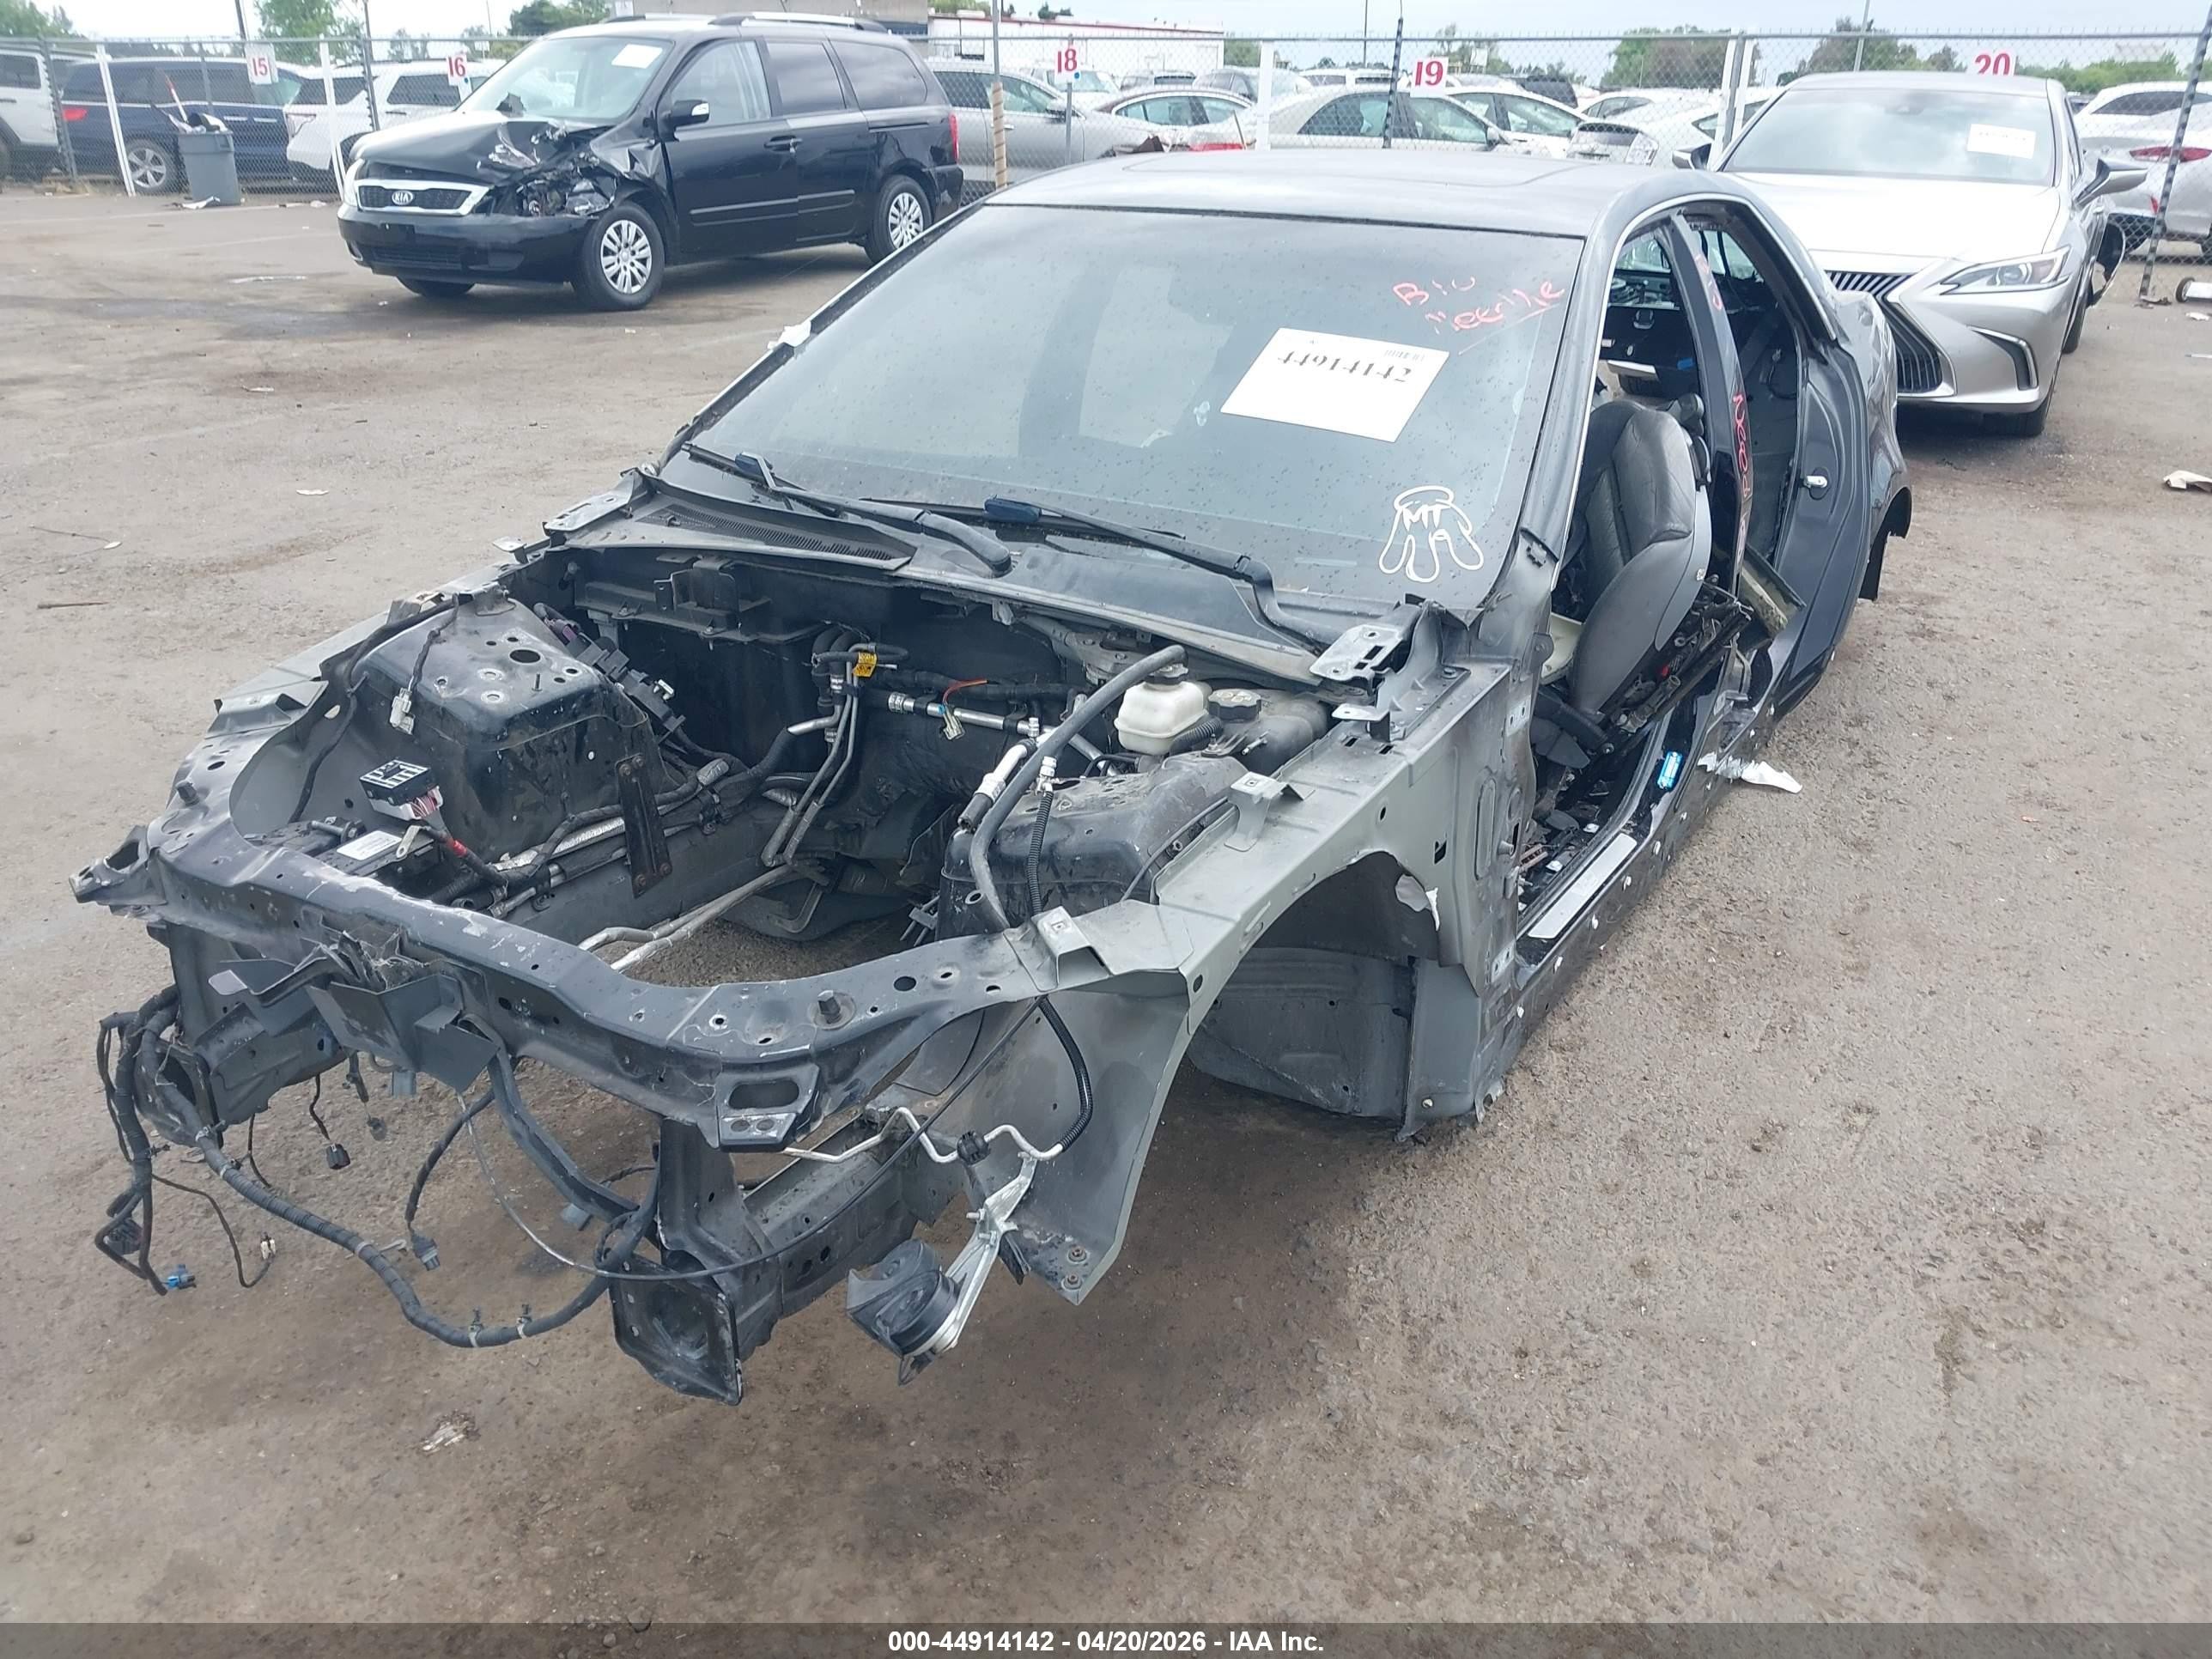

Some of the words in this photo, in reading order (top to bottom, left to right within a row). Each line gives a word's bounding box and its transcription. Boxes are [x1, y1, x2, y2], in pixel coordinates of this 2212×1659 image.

[252, 57, 268, 76] 15
[447, 56, 466, 77] 16
[1057, 48, 1078, 73] 18
[1974, 52, 2010, 76] 20
[1414, 60, 1443, 87] 19
[1277, 350, 1412, 383] 44914142
